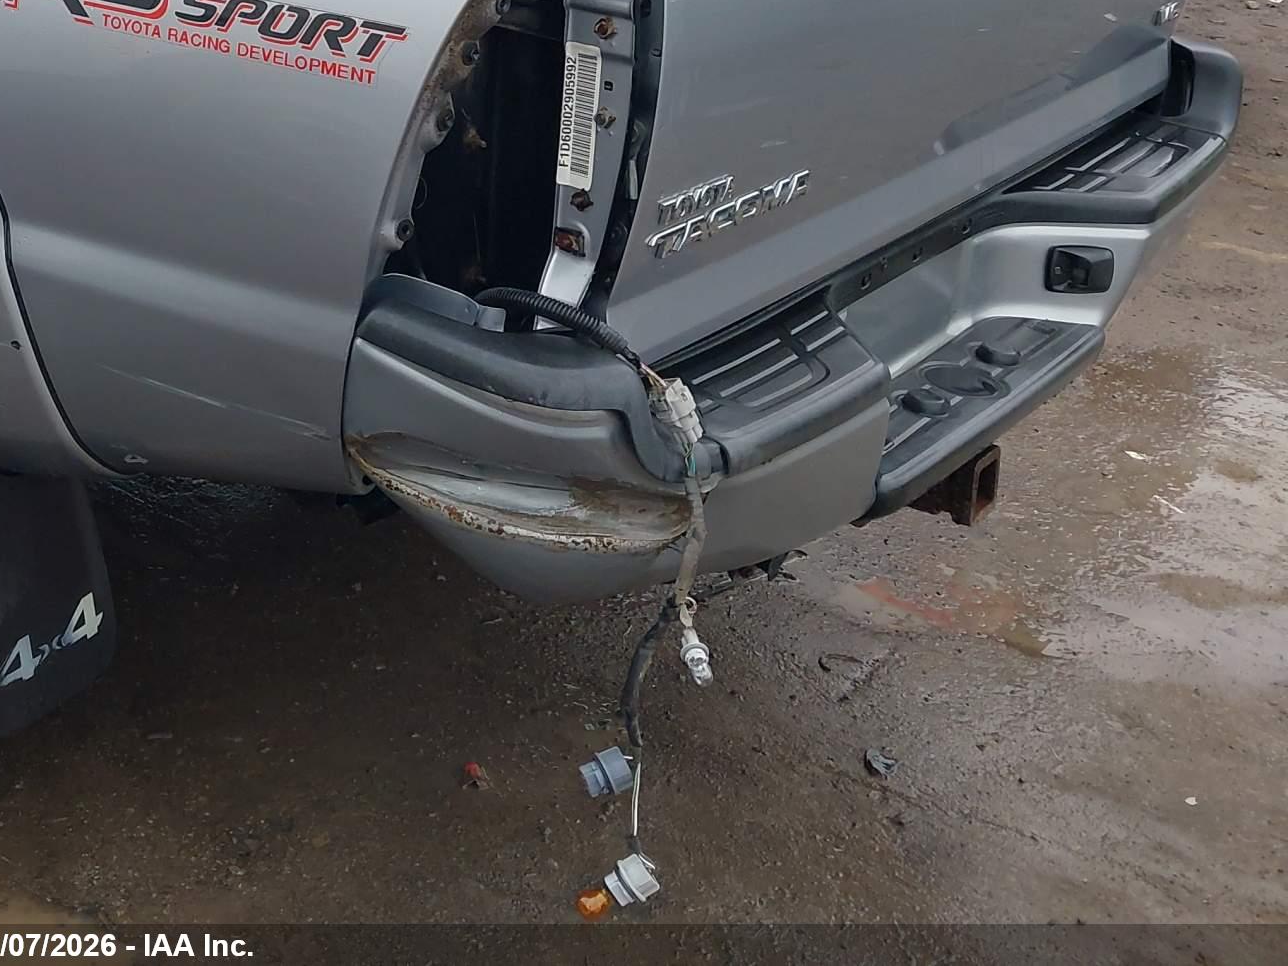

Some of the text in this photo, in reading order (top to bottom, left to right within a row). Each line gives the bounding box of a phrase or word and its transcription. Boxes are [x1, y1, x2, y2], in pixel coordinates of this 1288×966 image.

[101, 13, 377, 85] TOYOTA RACING DEVELOPMENT
[558, 56, 577, 168] F1D60002905992
[644, 169, 810, 259] TACOMA
[657, 174, 734, 226] TOYOTA
